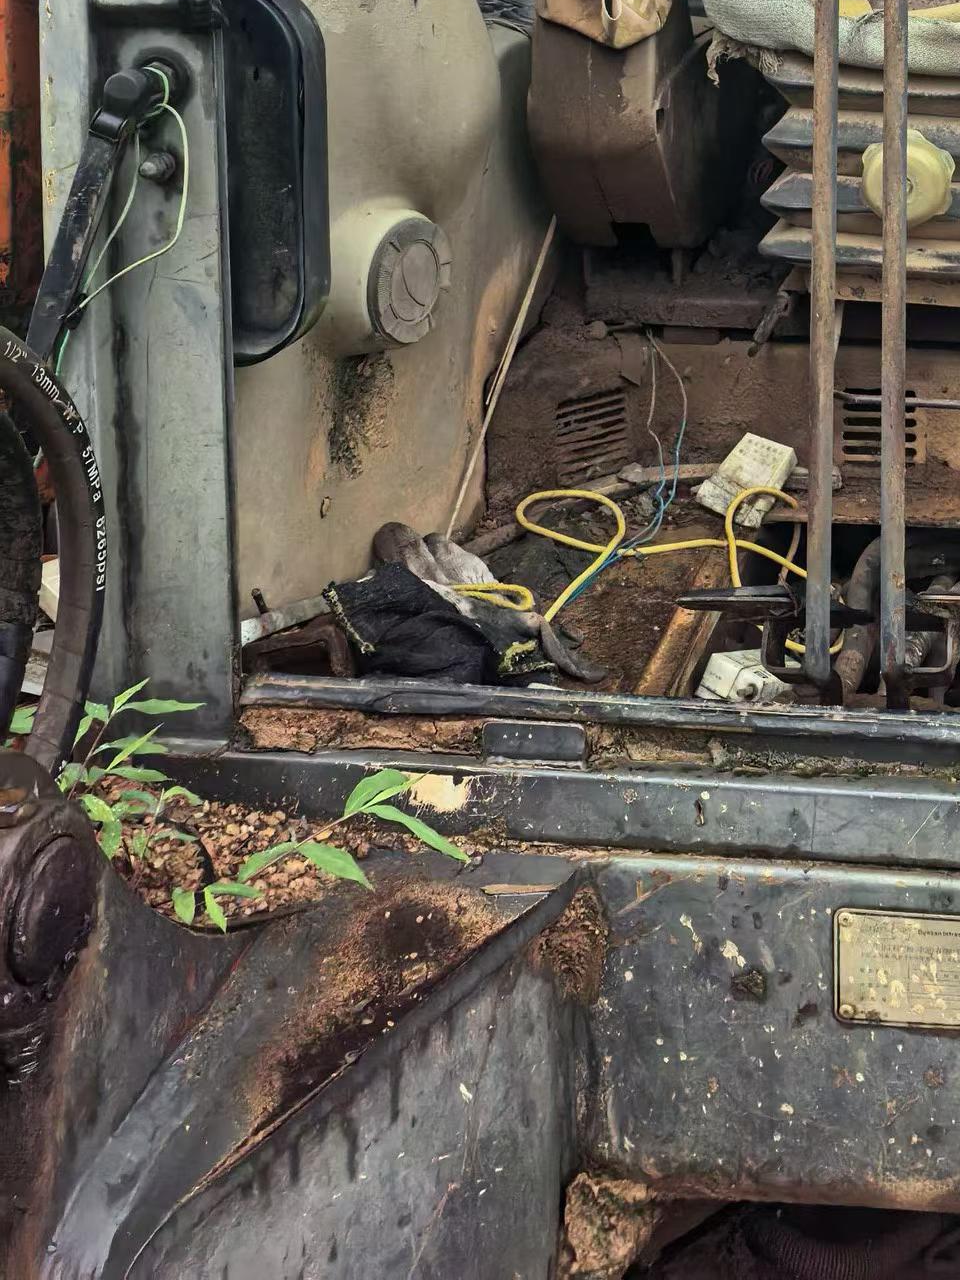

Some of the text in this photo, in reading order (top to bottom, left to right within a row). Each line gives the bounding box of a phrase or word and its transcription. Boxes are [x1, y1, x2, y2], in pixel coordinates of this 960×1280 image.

[3, 340, 28, 362] 1/2"
[31, 363, 60, 401] 13mm
[82, 445, 102, 503] 57MPa
[95, 516, 107, 592] 8265psi
